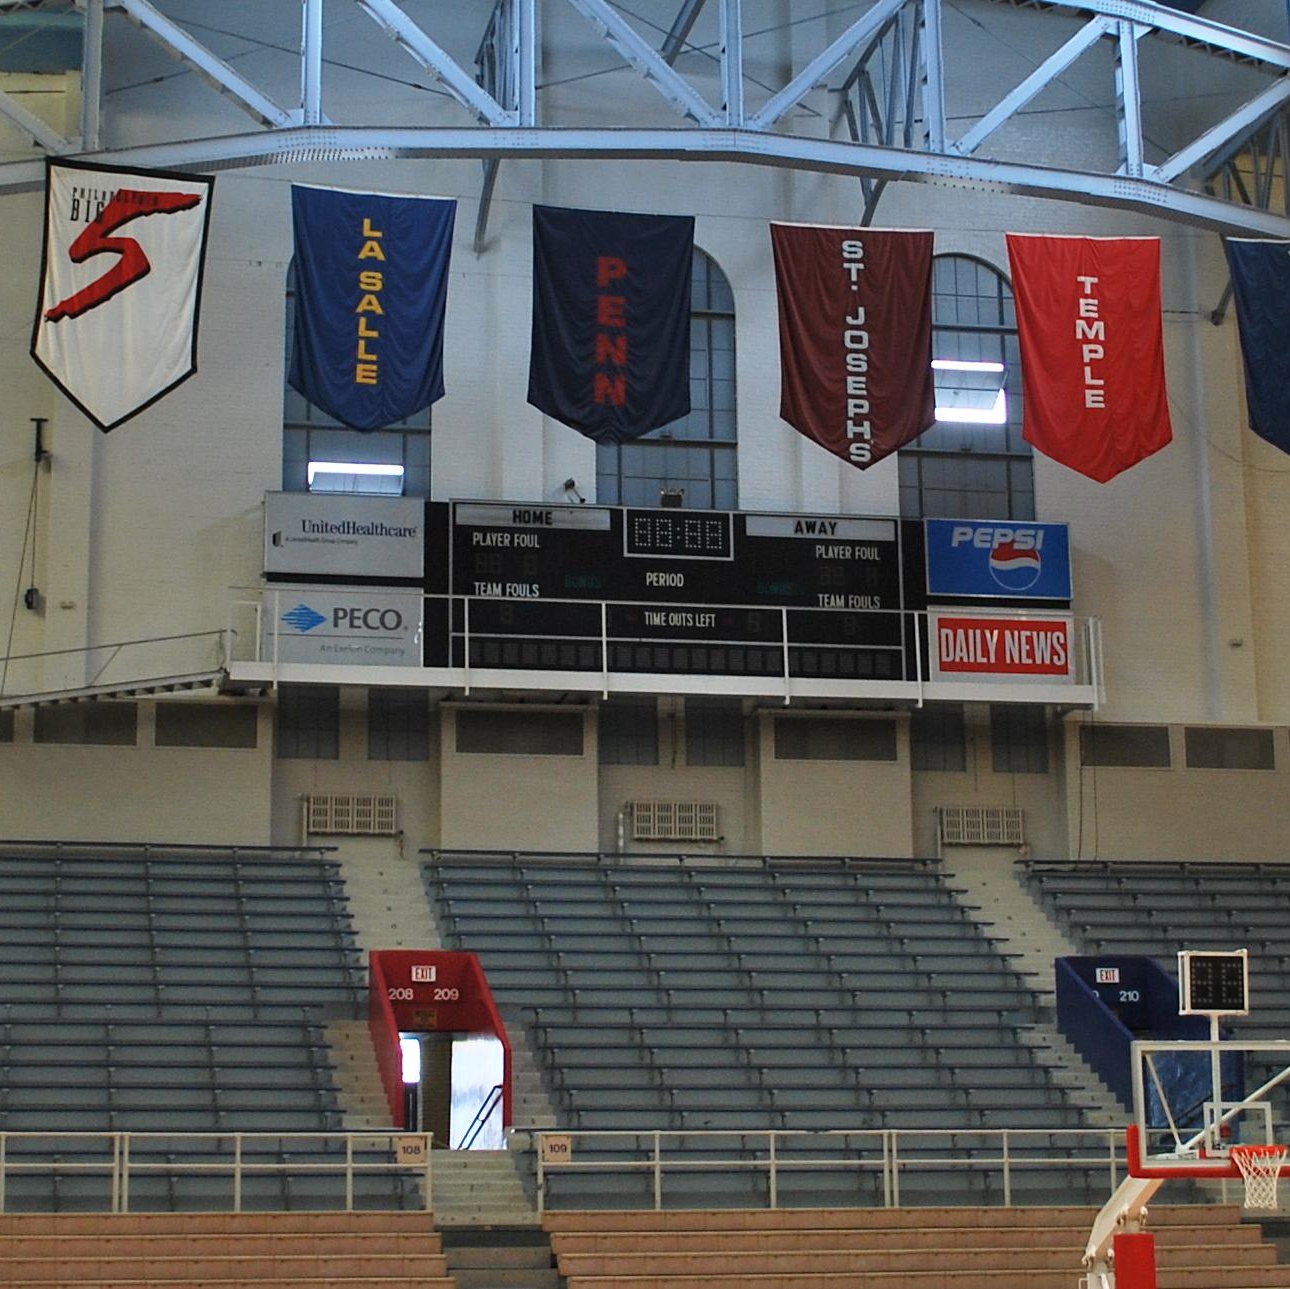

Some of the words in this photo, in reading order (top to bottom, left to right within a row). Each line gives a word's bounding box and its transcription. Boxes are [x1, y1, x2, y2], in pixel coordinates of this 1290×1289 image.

[358, 218, 386, 261] LA
[44, 188, 203, 324] 5
[841, 240, 864, 291] ST.
[355, 271, 385, 385] SALLE
[594, 256, 629, 408] PENN
[1075, 275, 1106, 408] TEMPLE
[512, 509, 553, 525] HOME
[301, 519, 417, 538] UnitedHealthcare
[794, 520, 837, 536] AWAY
[472, 531, 511, 548] PLAYER
[514, 533, 541, 549] FOUL
[951, 526, 1045, 551] PEPSI
[815, 544, 852, 560] PLAYER
[855, 546, 882, 561] FOUL
[645, 571, 685, 588] PERIOD
[473, 581, 503, 597] TEAM
[506, 582, 541, 598] FOULS
[817, 593, 845, 609] TEAM
[848, 594, 882, 610] FOULS
[332, 606, 404, 631] PECO
[644, 610, 667, 627] TIME
[669, 612, 694, 628] OUTS
[696, 613, 717, 628] LEFT
[940, 627, 999, 664] DAILY
[1004, 629, 1067, 667] NEWS
[415, 967, 432, 980] EXIT
[1099, 969, 1116, 981] EXIT
[388, 987, 414, 1000] 208
[433, 988, 459, 1001] 209
[1119, 990, 1140, 1002] 210
[402, 1145, 421, 1155] 108
[548, 1144, 567, 1153] 109
